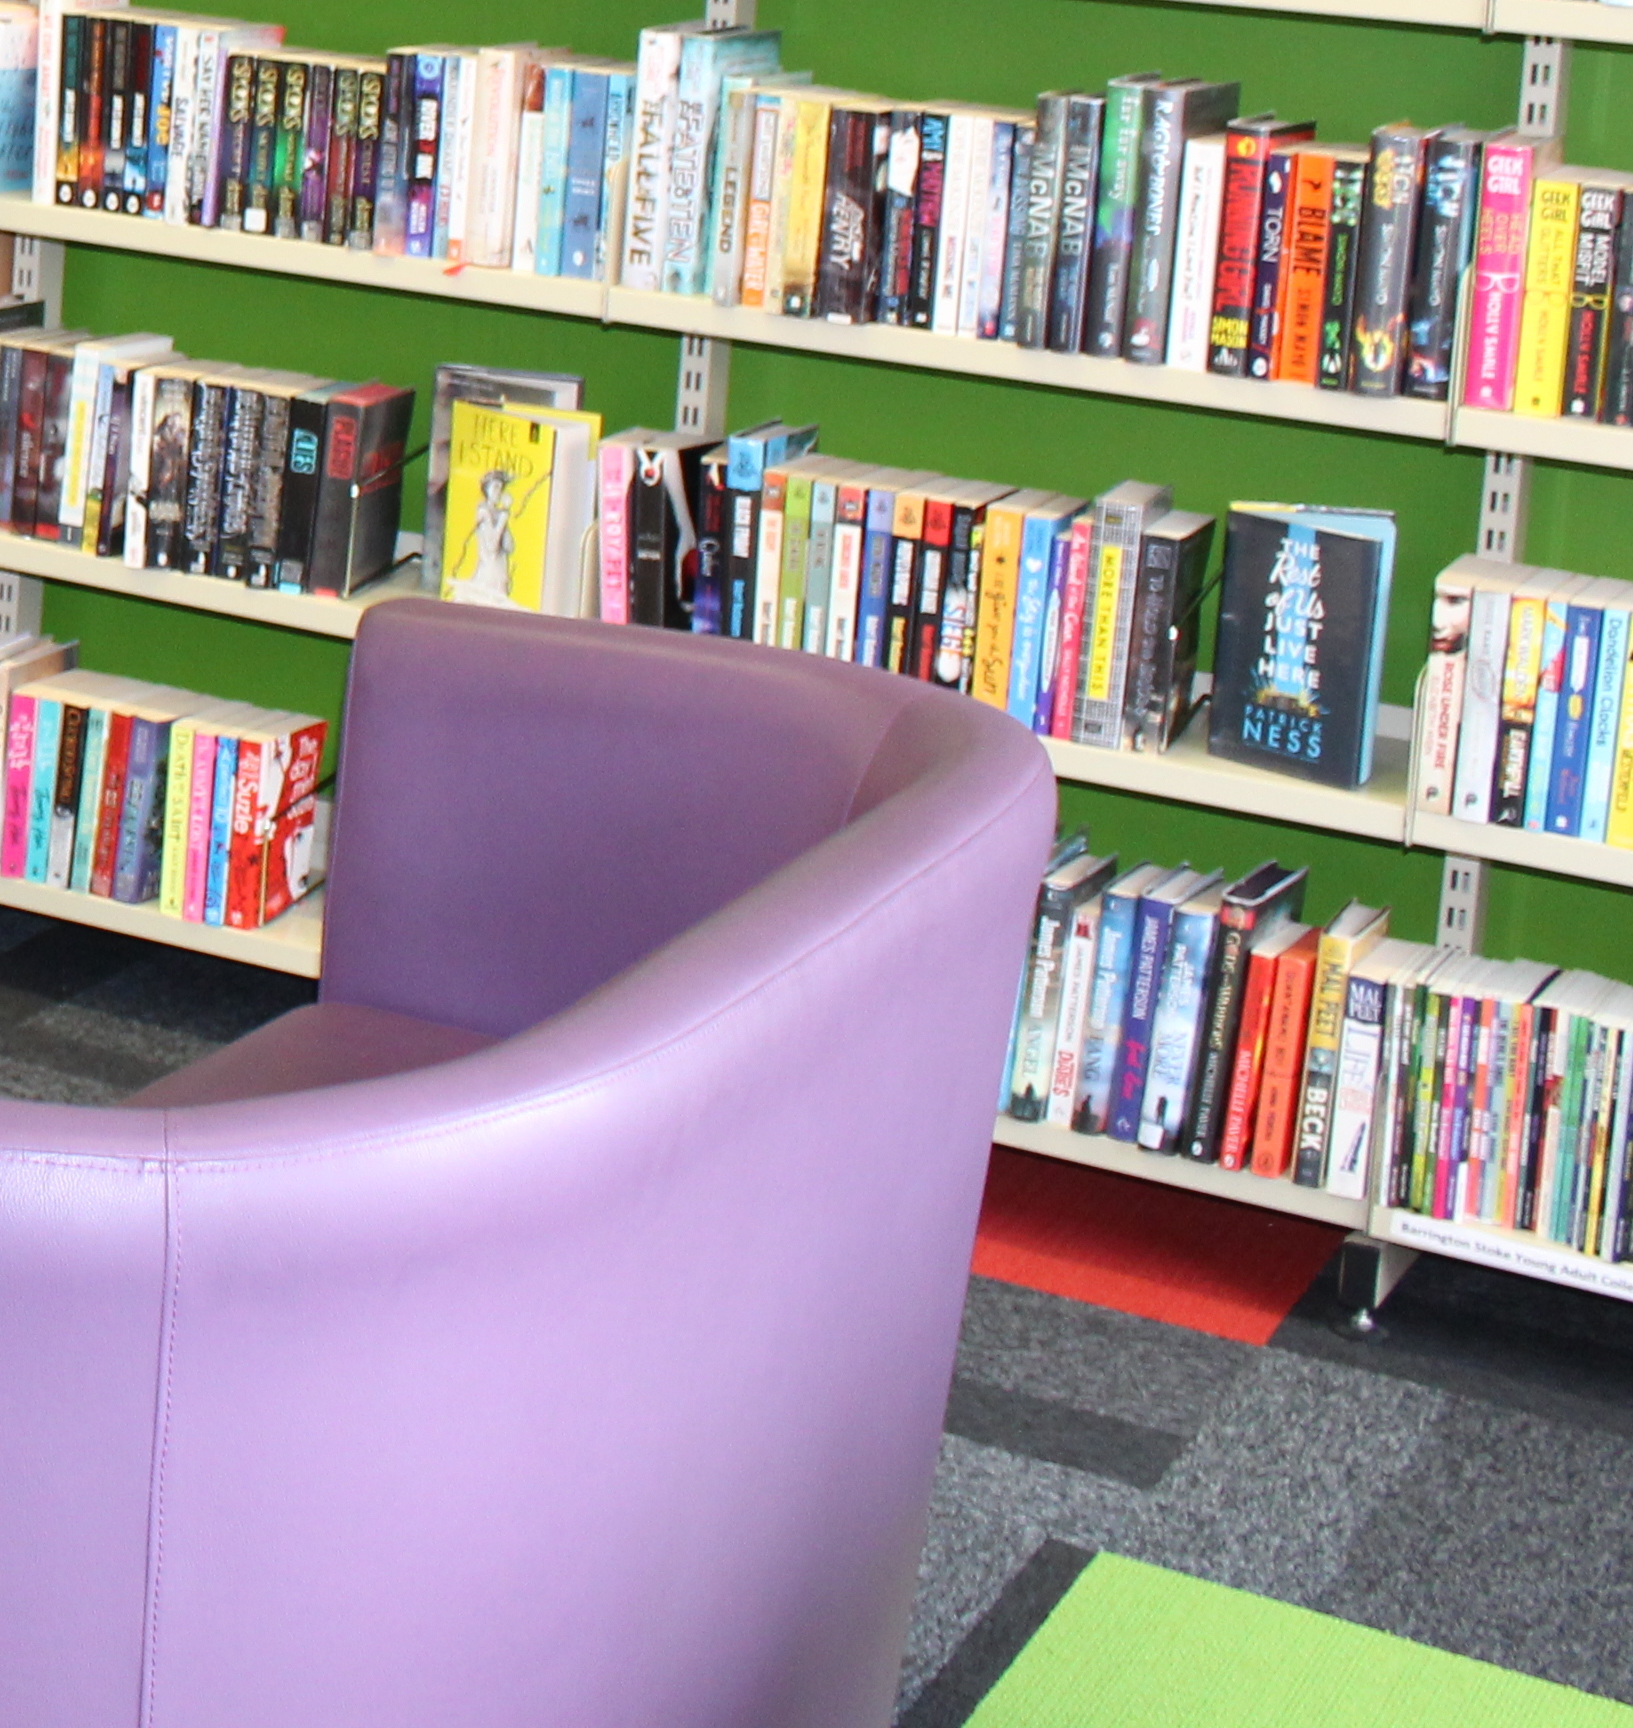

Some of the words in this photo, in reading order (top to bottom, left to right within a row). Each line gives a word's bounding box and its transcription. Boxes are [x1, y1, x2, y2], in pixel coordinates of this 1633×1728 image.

[171, 96, 189, 161] SALVAGE
[195, 121, 209, 161] NAME
[1154, 99, 1174, 152] RAGS
[1486, 155, 1524, 175] GEEK
[1486, 175, 1522, 195] GIRL
[718, 166, 738, 255] LEGEND
[1028, 144, 1057, 258] McNAB
[1060, 144, 1090, 258] McNAB
[1145, 176, 1165, 236] BONES
[1221, 162, 1262, 258] RUNNING
[1540, 207, 1568, 222] GIRL
[1541, 191, 1571, 206] GEEK
[1580, 211, 1612, 229] GIRL
[1581, 192, 1614, 210] GEEK
[628, 197, 657, 267] FIVE
[666, 208, 693, 264] TEN
[829, 194, 852, 270] HENRY
[1262, 207, 1283, 263] TORN
[1292, 205, 1326, 277] BLAME
[745, 247, 764, 290] WATER
[1574, 233, 1594, 286] MISFIT
[1592, 235, 1610, 284] MODEL
[1217, 261, 1250, 312] GIRL
[1485, 291, 1501, 334] HOLLY
[1580, 310, 1594, 352] HOLLY
[290, 431, 318, 476] LIES
[473, 414, 520, 450] HERE
[465, 441, 533, 478] STAND
[1268, 548, 1321, 587] Rest
[1279, 537, 1320, 563] THE
[1102, 555, 1117, 598] MORE
[1264, 608, 1323, 642] JUST
[1297, 590, 1326, 620] Us
[1097, 606, 1111, 648] THAN
[1263, 636, 1318, 665] LIVE
[1602, 618, 1622, 693] Dandelion
[1090, 656, 1107, 692] THIS
[1257, 656, 1321, 691] HERE
[1442, 661, 1455, 694] ROSE
[1241, 719, 1322, 759] NESS
[1243, 704, 1323, 735] PATRICK
[1438, 696, 1452, 741] UNDER
[1595, 698, 1614, 747] Clocks
[1435, 743, 1448, 770] FIRE
[232, 778, 259, 835] Suzie
[1037, 917, 1061, 959] James
[1099, 926, 1122, 970] James
[1138, 916, 1159, 953] JAMES
[1028, 960, 1055, 1019] Patterson
[1131, 955, 1153, 1020] PATTERSON
[1166, 942, 1188, 1017] PATTERSON
[1177, 964, 1198, 1007] JAMES
[1321, 962, 1343, 995] MAL
[1348, 983, 1380, 1003] MAL
[1089, 972, 1117, 1030] Patterson
[1315, 998, 1339, 1038] PEET
[1348, 1003, 1382, 1023] PEET
[1022, 1024, 1044, 1078] ANGEL
[1201, 1052, 1219, 1106] MICHELLE
[1229, 1049, 1252, 1115] MICHELLE
[1195, 1107, 1213, 1138] PAVER
[1225, 1116, 1242, 1154] PAVER
[1301, 1086, 1329, 1151] BECK
[1401, 1222, 1471, 1251] Barrington
[1475, 1240, 1511, 1260] Stoke
[1515, 1249, 1557, 1276] Young
[1560, 1263, 1598, 1283] Adult
